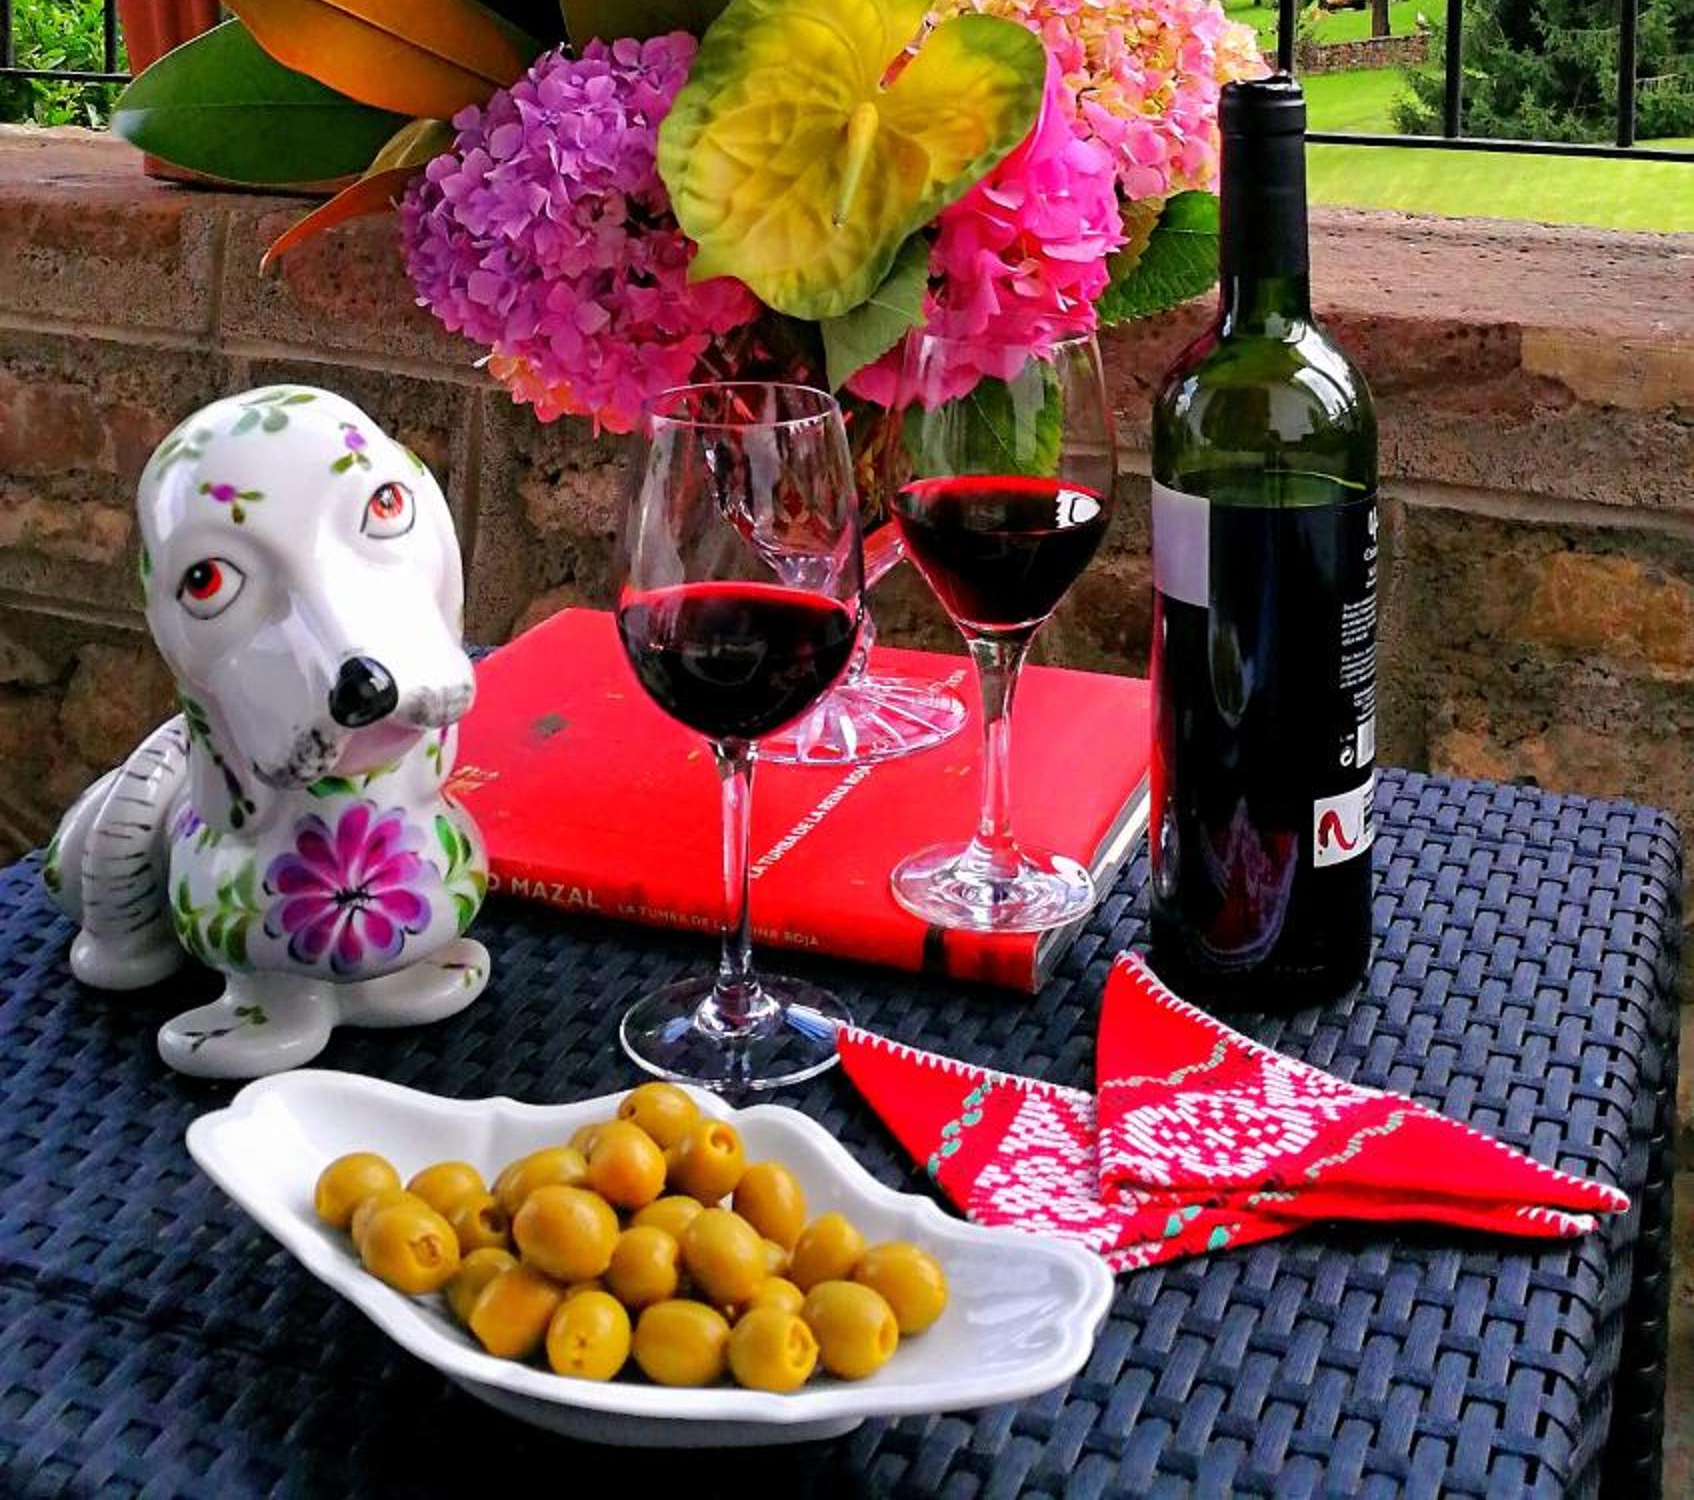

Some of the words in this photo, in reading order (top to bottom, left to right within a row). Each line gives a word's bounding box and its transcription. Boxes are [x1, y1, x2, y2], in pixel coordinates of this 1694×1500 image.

[803, 811, 828, 823] LA
[791, 820, 815, 835] DE
[757, 835, 802, 865] TUMBA
[750, 865, 768, 879] LA
[511, 876, 602, 909] MAZAL
[783, 931, 819, 947] ROJA
